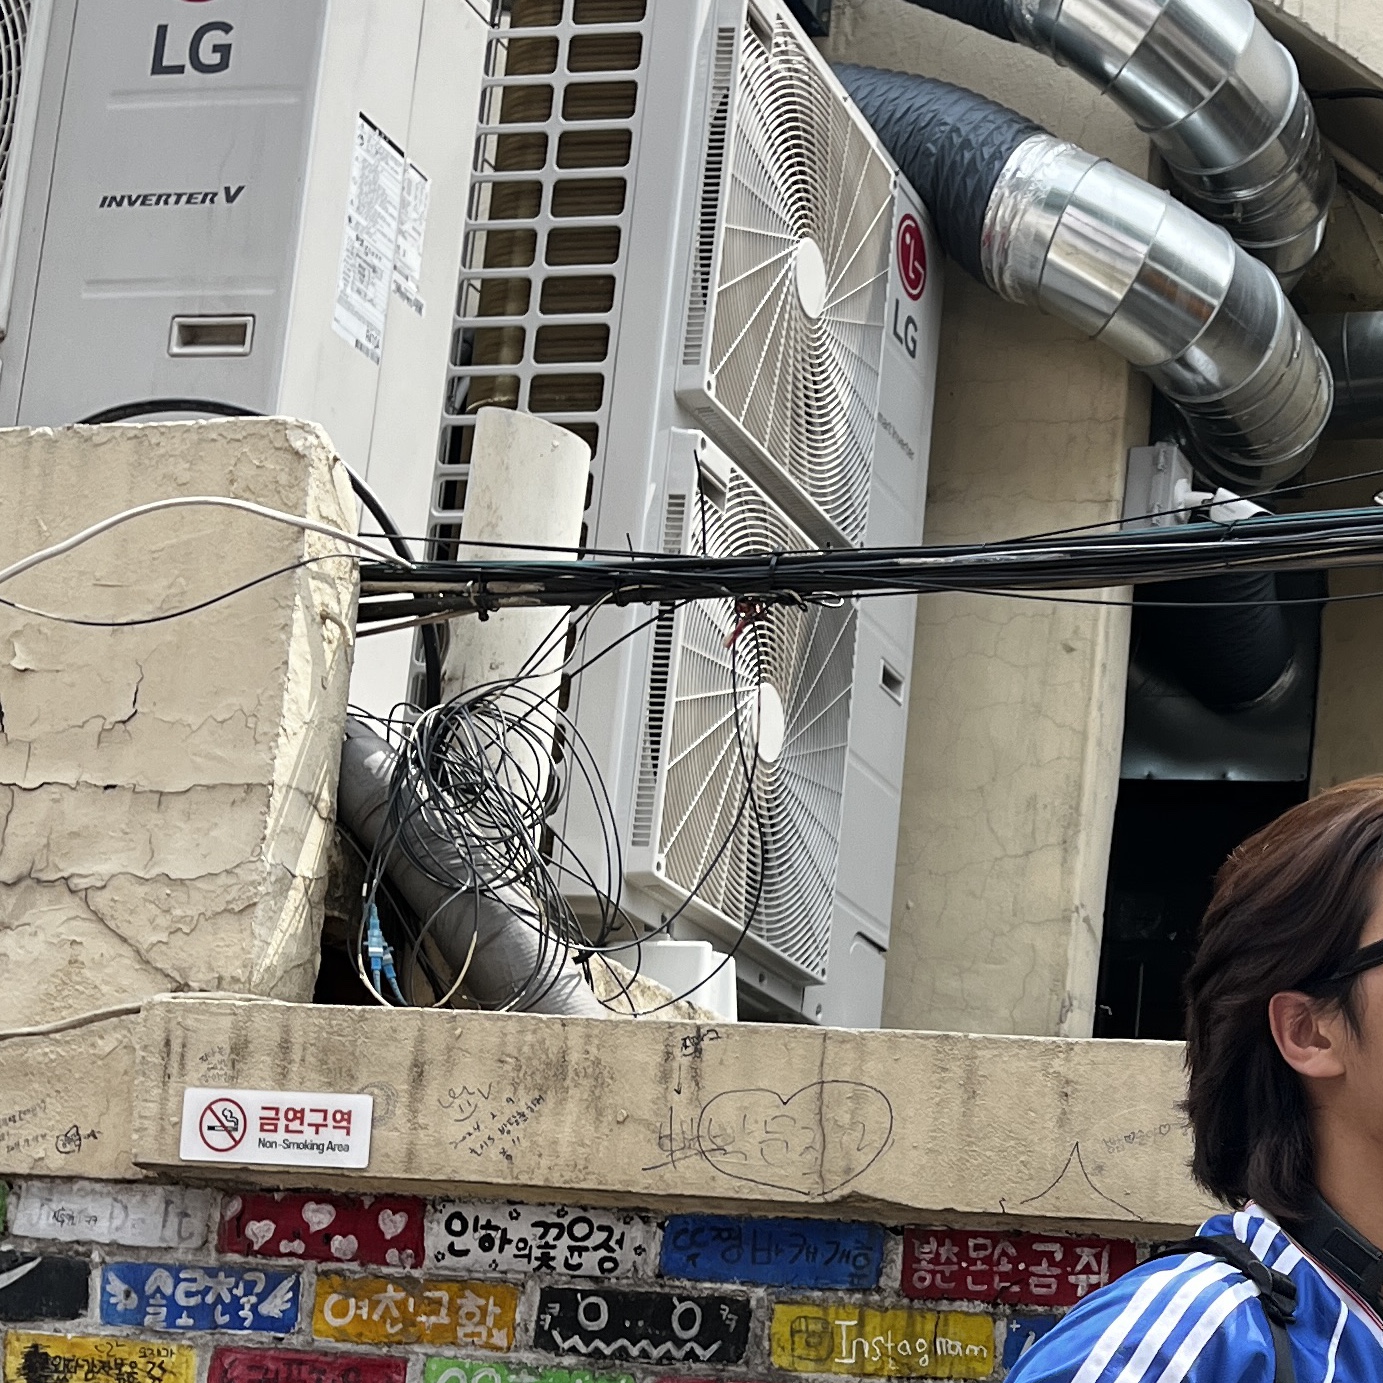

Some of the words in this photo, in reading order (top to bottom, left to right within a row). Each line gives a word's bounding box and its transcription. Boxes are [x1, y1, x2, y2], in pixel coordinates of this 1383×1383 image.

[150, 21, 234, 76] LG
[99, 191, 218, 208] INVERTER
[223, 185, 245, 204] V
[893, 298, 918, 359] LG
[258, 1106, 352, 1136] 금연구역
[326, 1141, 350, 1153] Area
